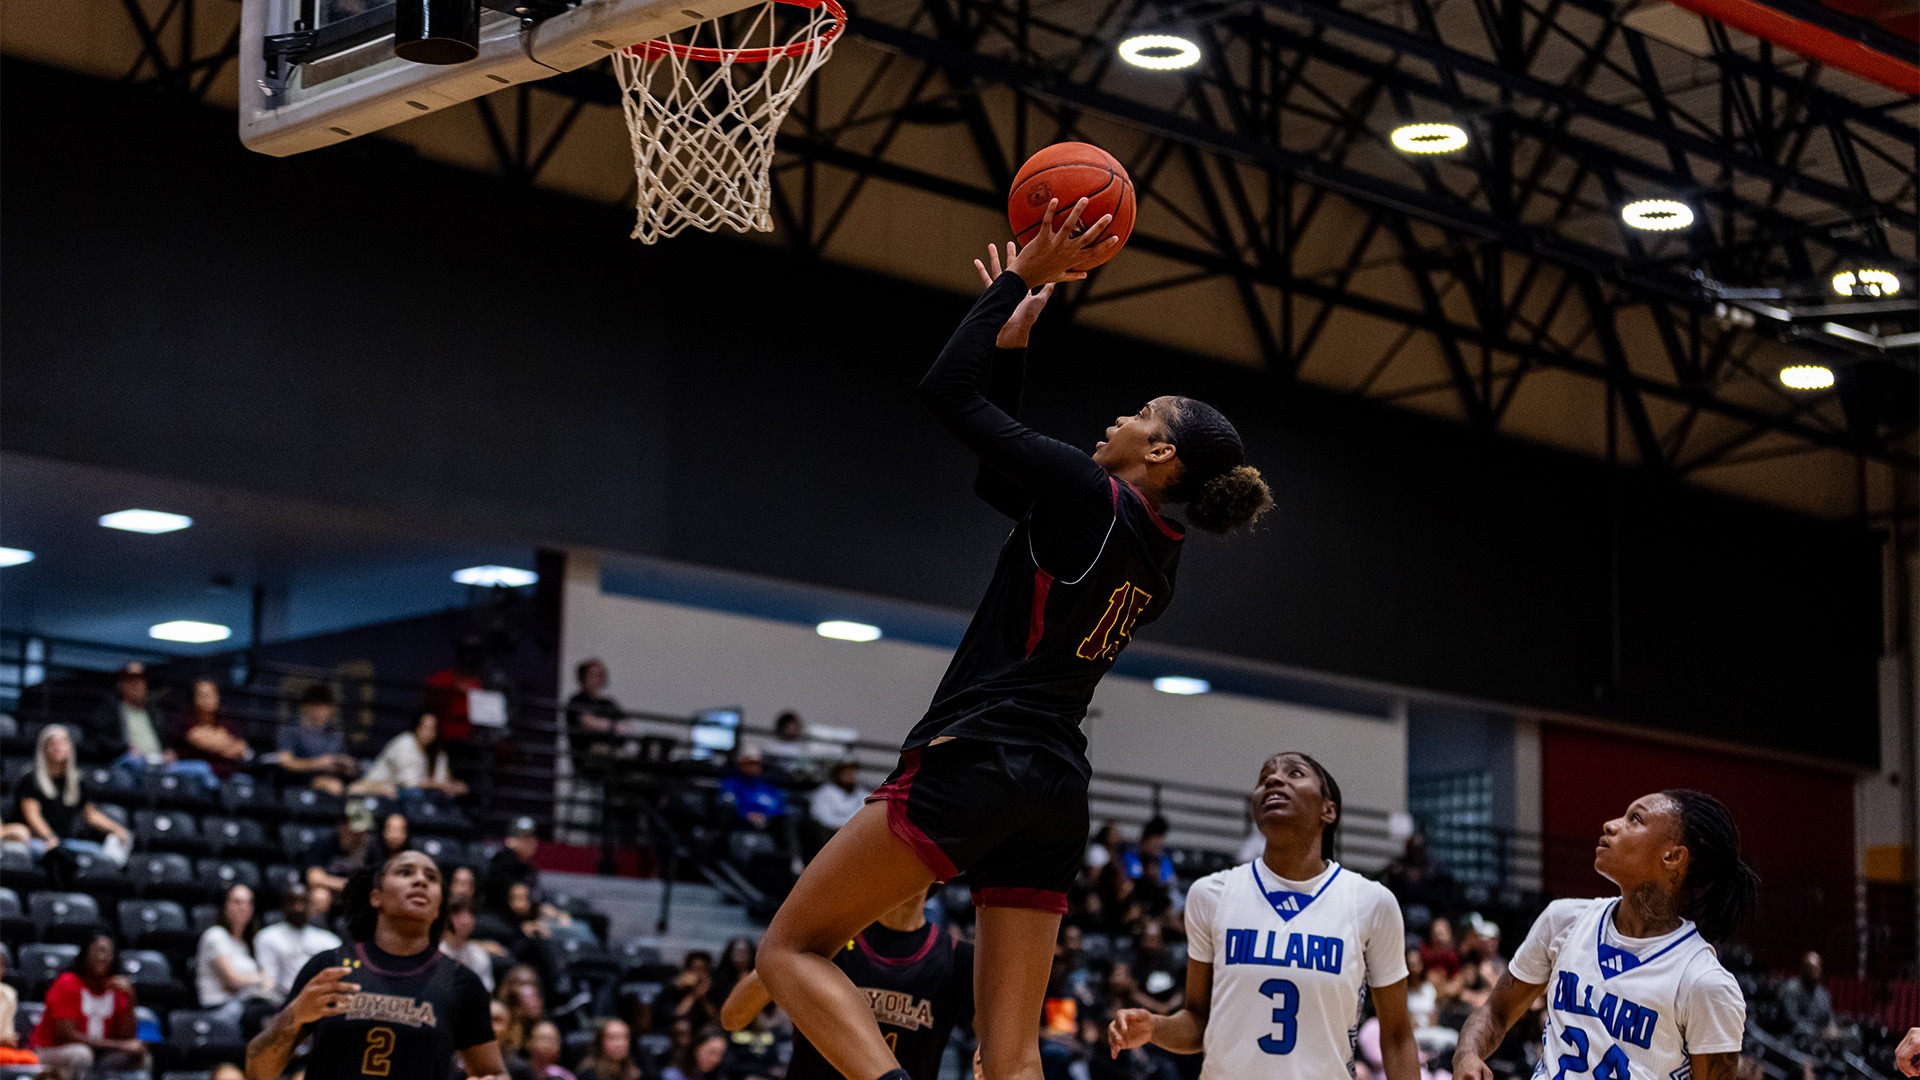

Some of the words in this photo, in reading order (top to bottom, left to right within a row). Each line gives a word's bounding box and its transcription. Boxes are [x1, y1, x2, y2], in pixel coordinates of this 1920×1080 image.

[1225, 928, 1344, 975] DILLARD
[345, 992, 436, 1028] OYOLA
[1257, 978, 1300, 1056] 3
[1553, 970, 1659, 1050] DILLARD
[361, 1026, 396, 1077] 2
[1551, 1025, 1631, 1080] 24
